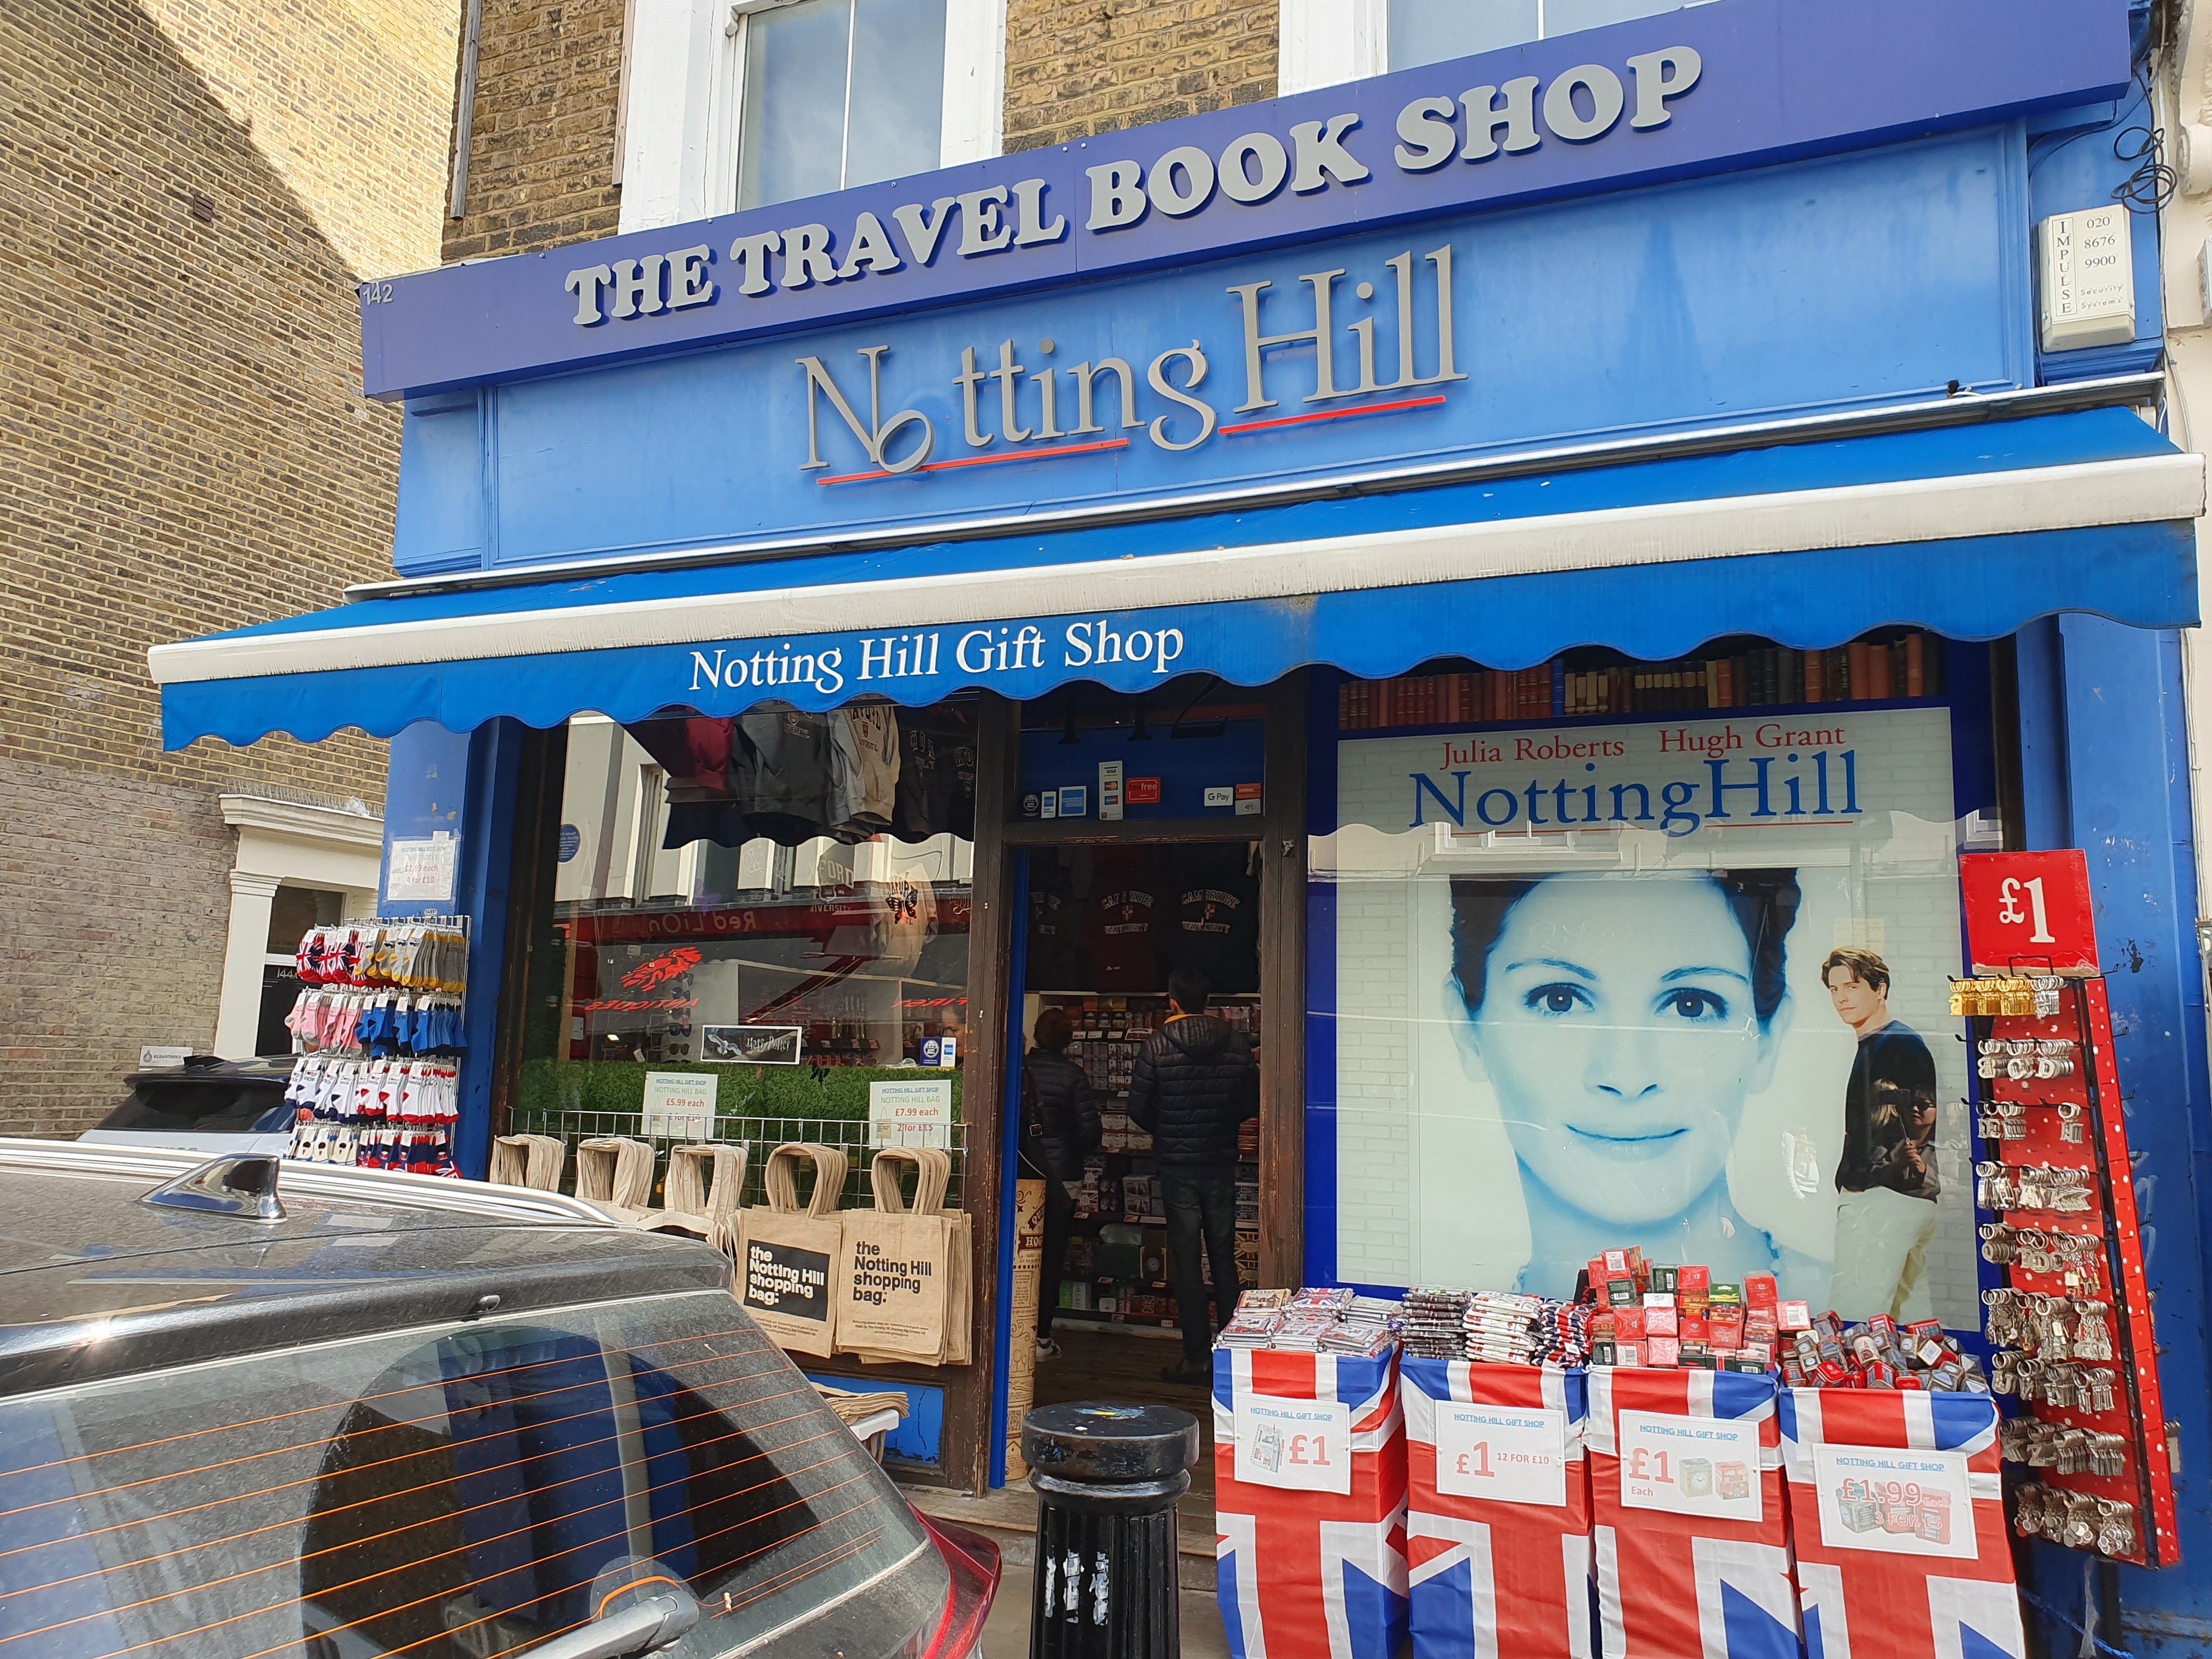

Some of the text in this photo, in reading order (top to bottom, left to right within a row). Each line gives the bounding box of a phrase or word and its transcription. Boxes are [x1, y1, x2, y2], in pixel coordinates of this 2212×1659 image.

[565, 46, 1702, 326] THE TRAVEL BOOK SHOP
[2086, 216, 2111, 229] 020
[2084, 235, 2117, 249] 8676
[2085, 255, 2117, 269] 9900
[363, 284, 393, 306] 142
[2080, 284, 2124, 296] Security
[2081, 298, 2122, 309] Systems
[795, 245, 1469, 474] Notting Hill
[689, 619, 1184, 694] Notting Hill Gift Shop
[1440, 723, 1846, 771] Julia Roberts Hugh Grant
[1217, 793, 1229, 802] Pay
[1998, 877, 2056, 944] £1
[746, 1036, 790, 1052] Harry Potter
[895, 1107, 939, 1116] £7.99 each
[750, 1246, 772, 1262] the
[856, 1241, 880, 1255] the
[749, 1259, 825, 1286] Notting Hill
[854, 1256, 932, 1277] Notting Hill
[749, 1273, 814, 1299] shopping
[854, 1272, 921, 1294] shopping
[1250, 1407, 1279, 1417] NOTTING
[1454, 1413, 1487, 1423] NOTTING
[1640, 1425, 1675, 1435] NOTTING
[1716, 1432, 1738, 1441] SHOP
[1289, 1435, 1330, 1466] £1
[1457, 1441, 1549, 1477] £1 12 FOR £10
[1628, 1447, 1674, 1483] £1
[1836, 1457, 1945, 1471] NOTTING HILL GIFT SHOP
[1631, 1486, 1654, 1497] Each
[1841, 1478, 1949, 1508] £1.99 Each
[1875, 1512, 1943, 1529] 3 FOR £5
